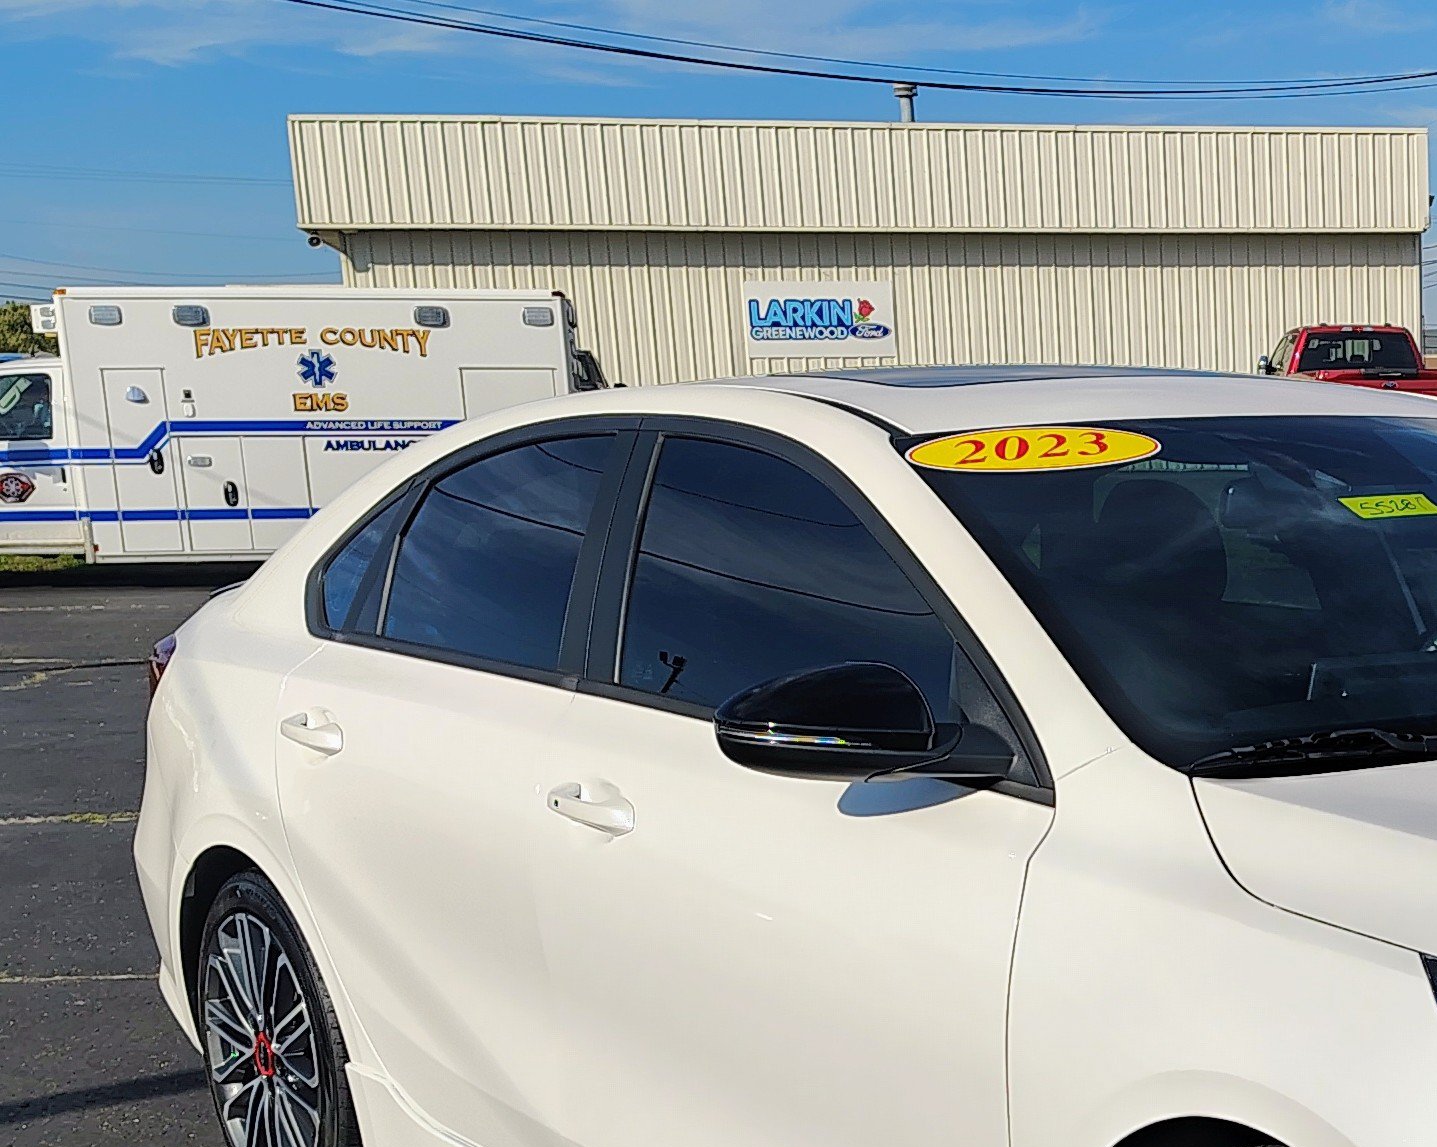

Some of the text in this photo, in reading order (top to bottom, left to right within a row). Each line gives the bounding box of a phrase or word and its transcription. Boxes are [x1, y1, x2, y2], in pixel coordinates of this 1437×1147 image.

[749, 299, 854, 327] LARKIN
[751, 326, 849, 340] GREENEWOOD
[854, 324, 887, 338] Ford
[193, 327, 432, 359] FAYETTE COUNTY
[293, 393, 349, 412] EMS
[306, 421, 442, 430] ADVANCED LIFE SUPPORT
[954, 432, 1109, 465] 2023
